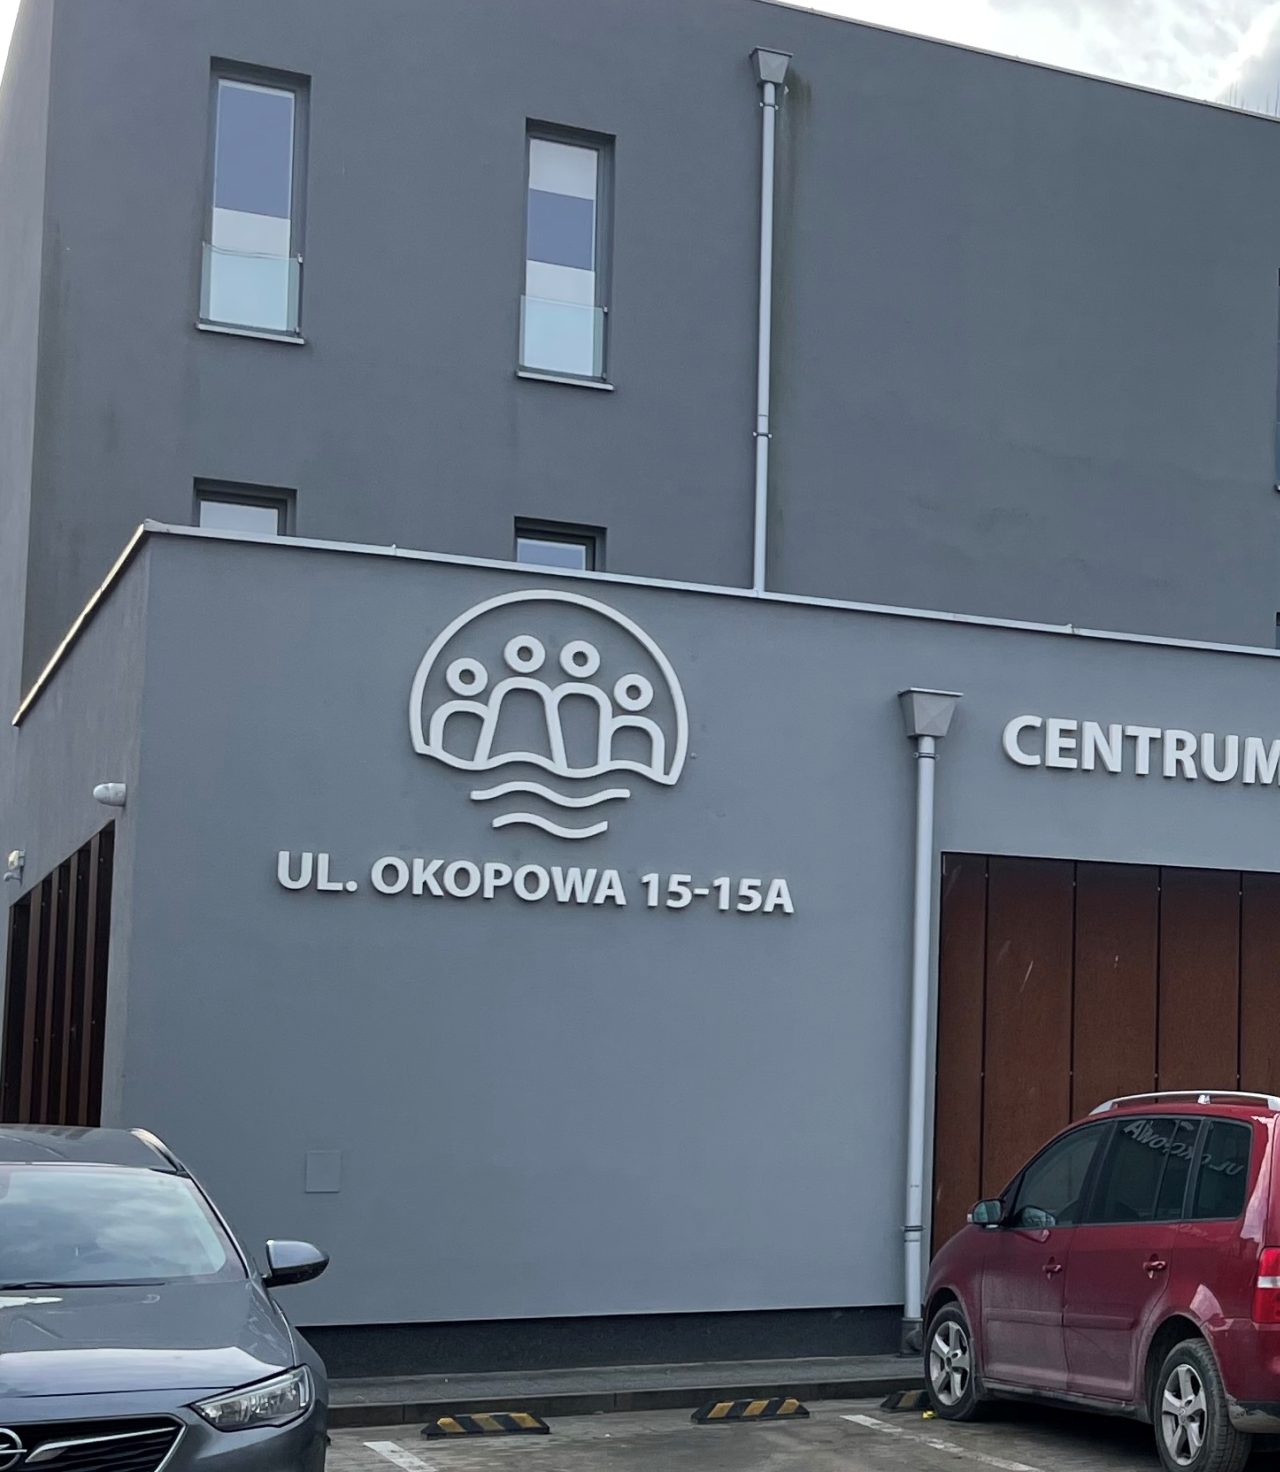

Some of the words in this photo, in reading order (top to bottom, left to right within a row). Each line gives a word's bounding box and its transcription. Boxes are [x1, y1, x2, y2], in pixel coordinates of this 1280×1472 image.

[277, 850, 359, 892] UL.
[371, 855, 627, 906] OKOPOWA
[640, 872, 795, 914] 15-15A
